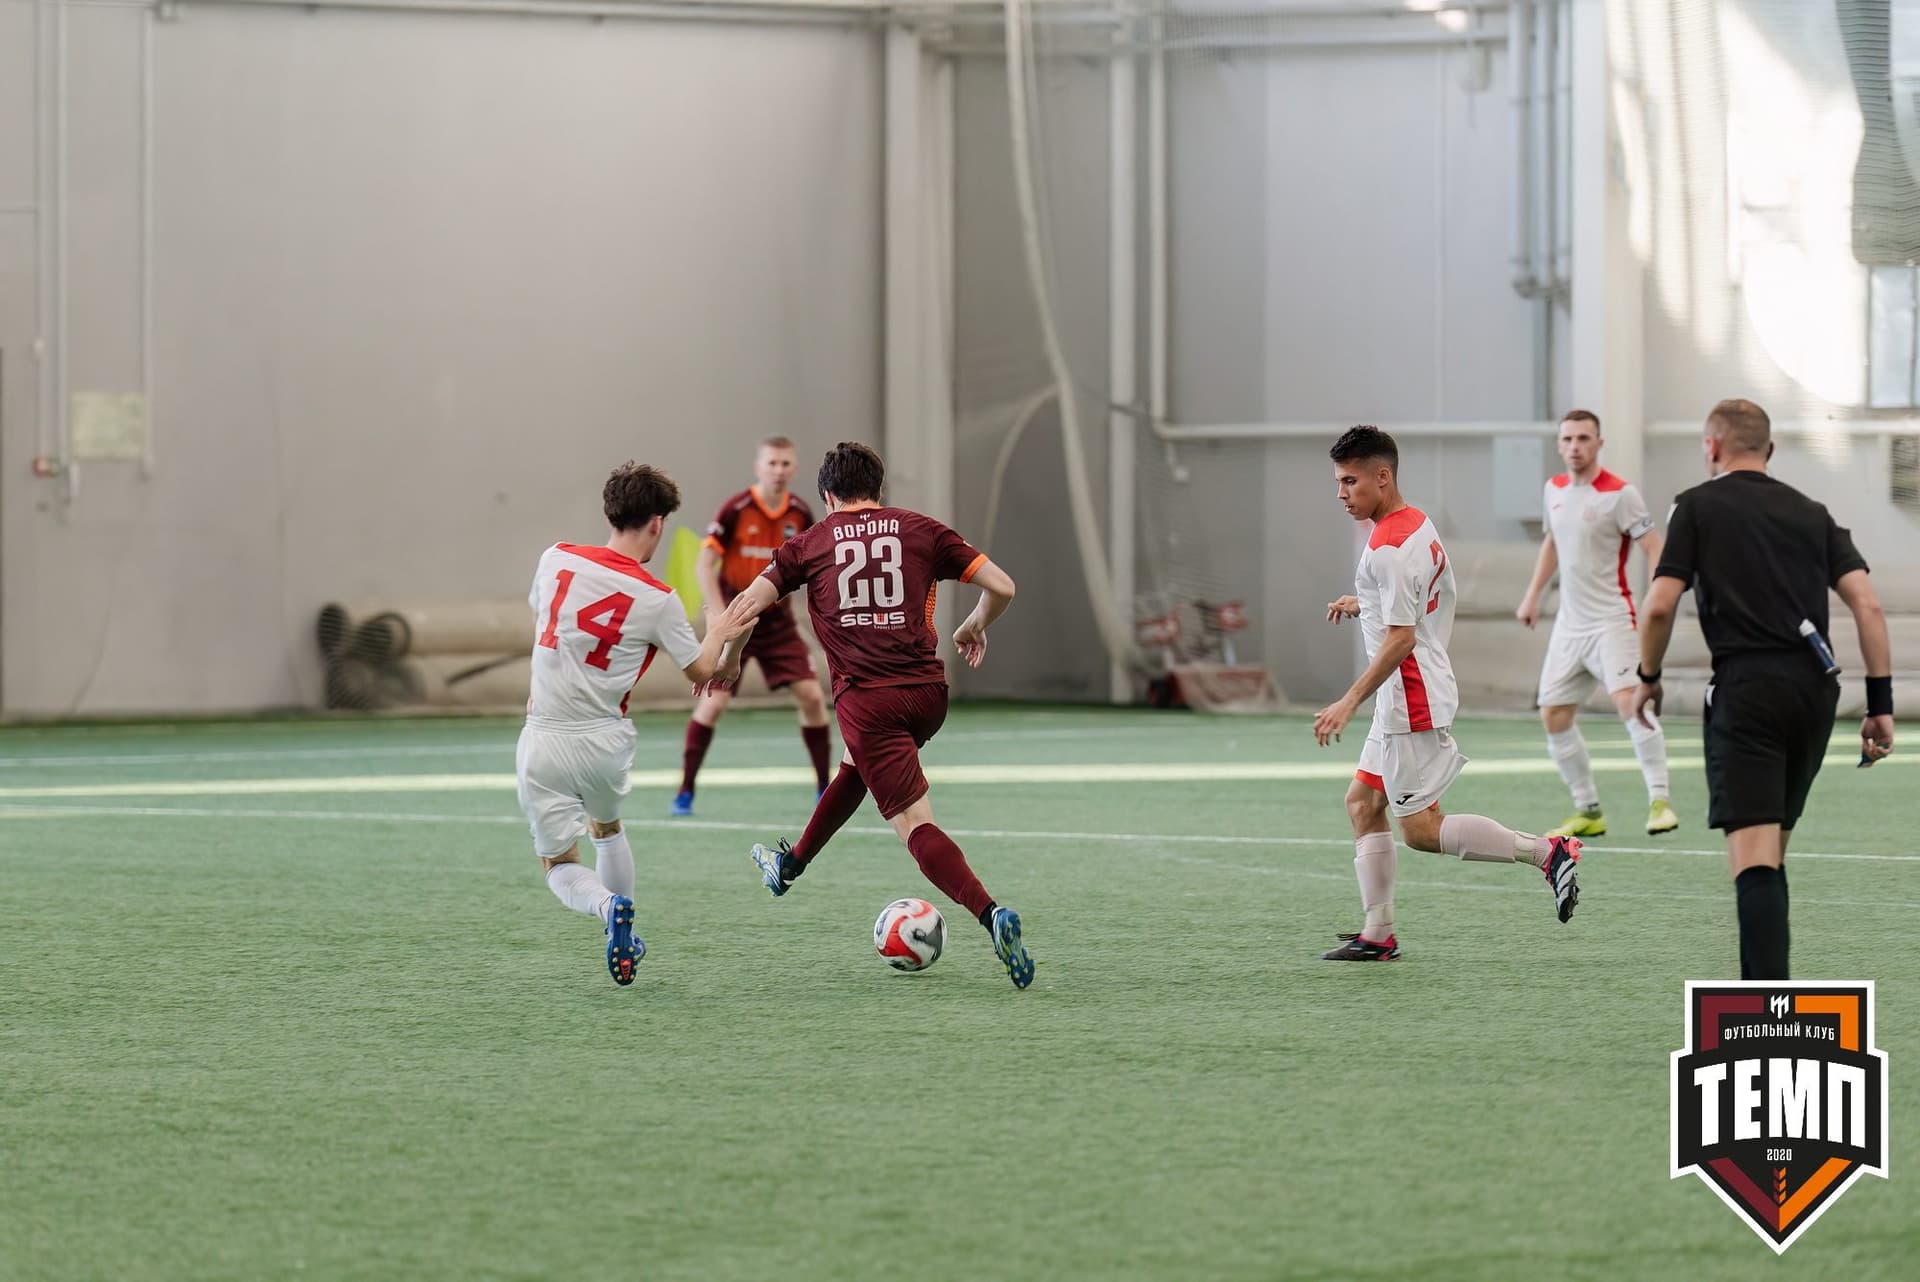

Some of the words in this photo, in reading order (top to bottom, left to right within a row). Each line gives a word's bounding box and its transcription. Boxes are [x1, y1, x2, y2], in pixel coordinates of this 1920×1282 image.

[833, 518, 899, 541] ВОРОНА
[835, 536, 905, 610] 23
[538, 569, 636, 671] 14
[840, 611, 906, 627] SEUS
